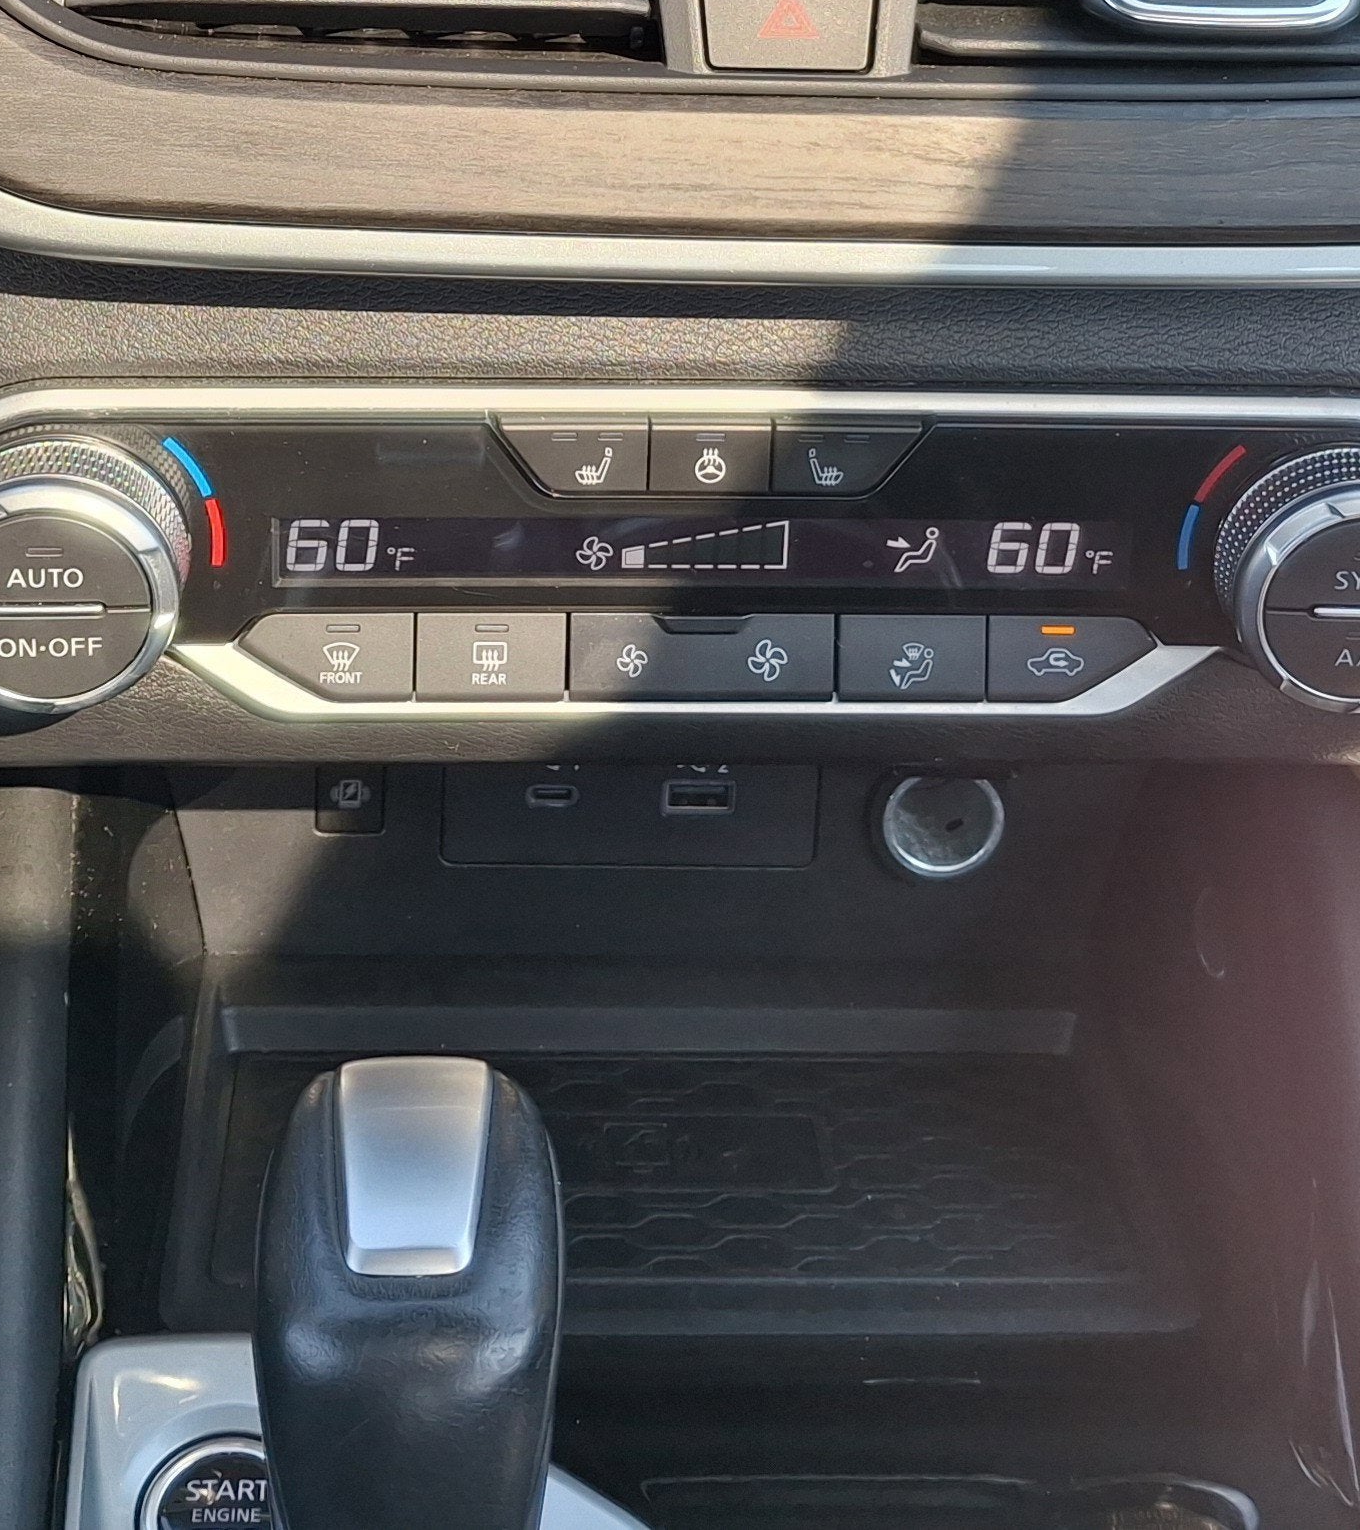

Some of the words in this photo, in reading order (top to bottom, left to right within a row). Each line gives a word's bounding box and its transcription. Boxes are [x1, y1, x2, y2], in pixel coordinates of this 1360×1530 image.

[6, 567, 84, 589] AUTO
[319, 672, 362, 684] FRONT
[472, 673, 506, 685] REAR
[186, 1479, 268, 1502] START
[191, 1507, 262, 1523] ENGINE
